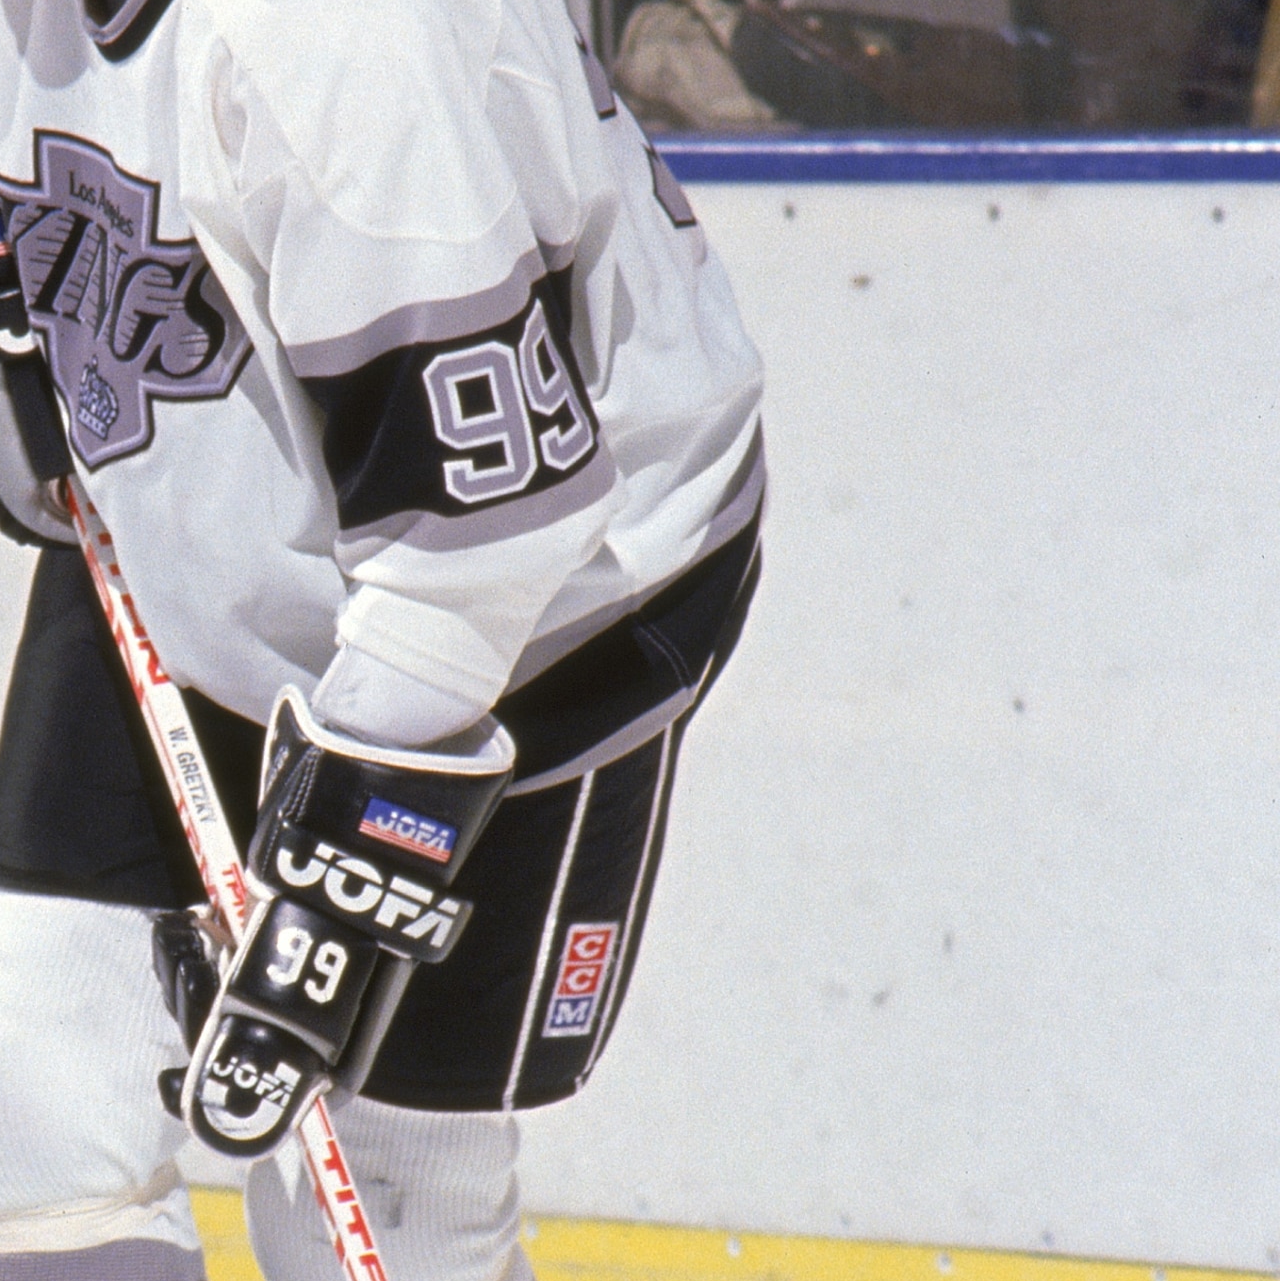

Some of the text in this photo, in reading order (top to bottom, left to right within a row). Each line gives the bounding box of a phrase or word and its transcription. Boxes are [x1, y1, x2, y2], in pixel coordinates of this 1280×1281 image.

[67, 169, 97, 206] Los
[422, 297, 597, 504] 99
[168, 726, 217, 824] W. GRETZKY
[375, 810, 450, 852] JOFA
[275, 841, 462, 949] JOFA
[265, 925, 349, 1005] 99
[551, 931, 609, 1027] CCM
[212, 1056, 295, 1109] JOFA
